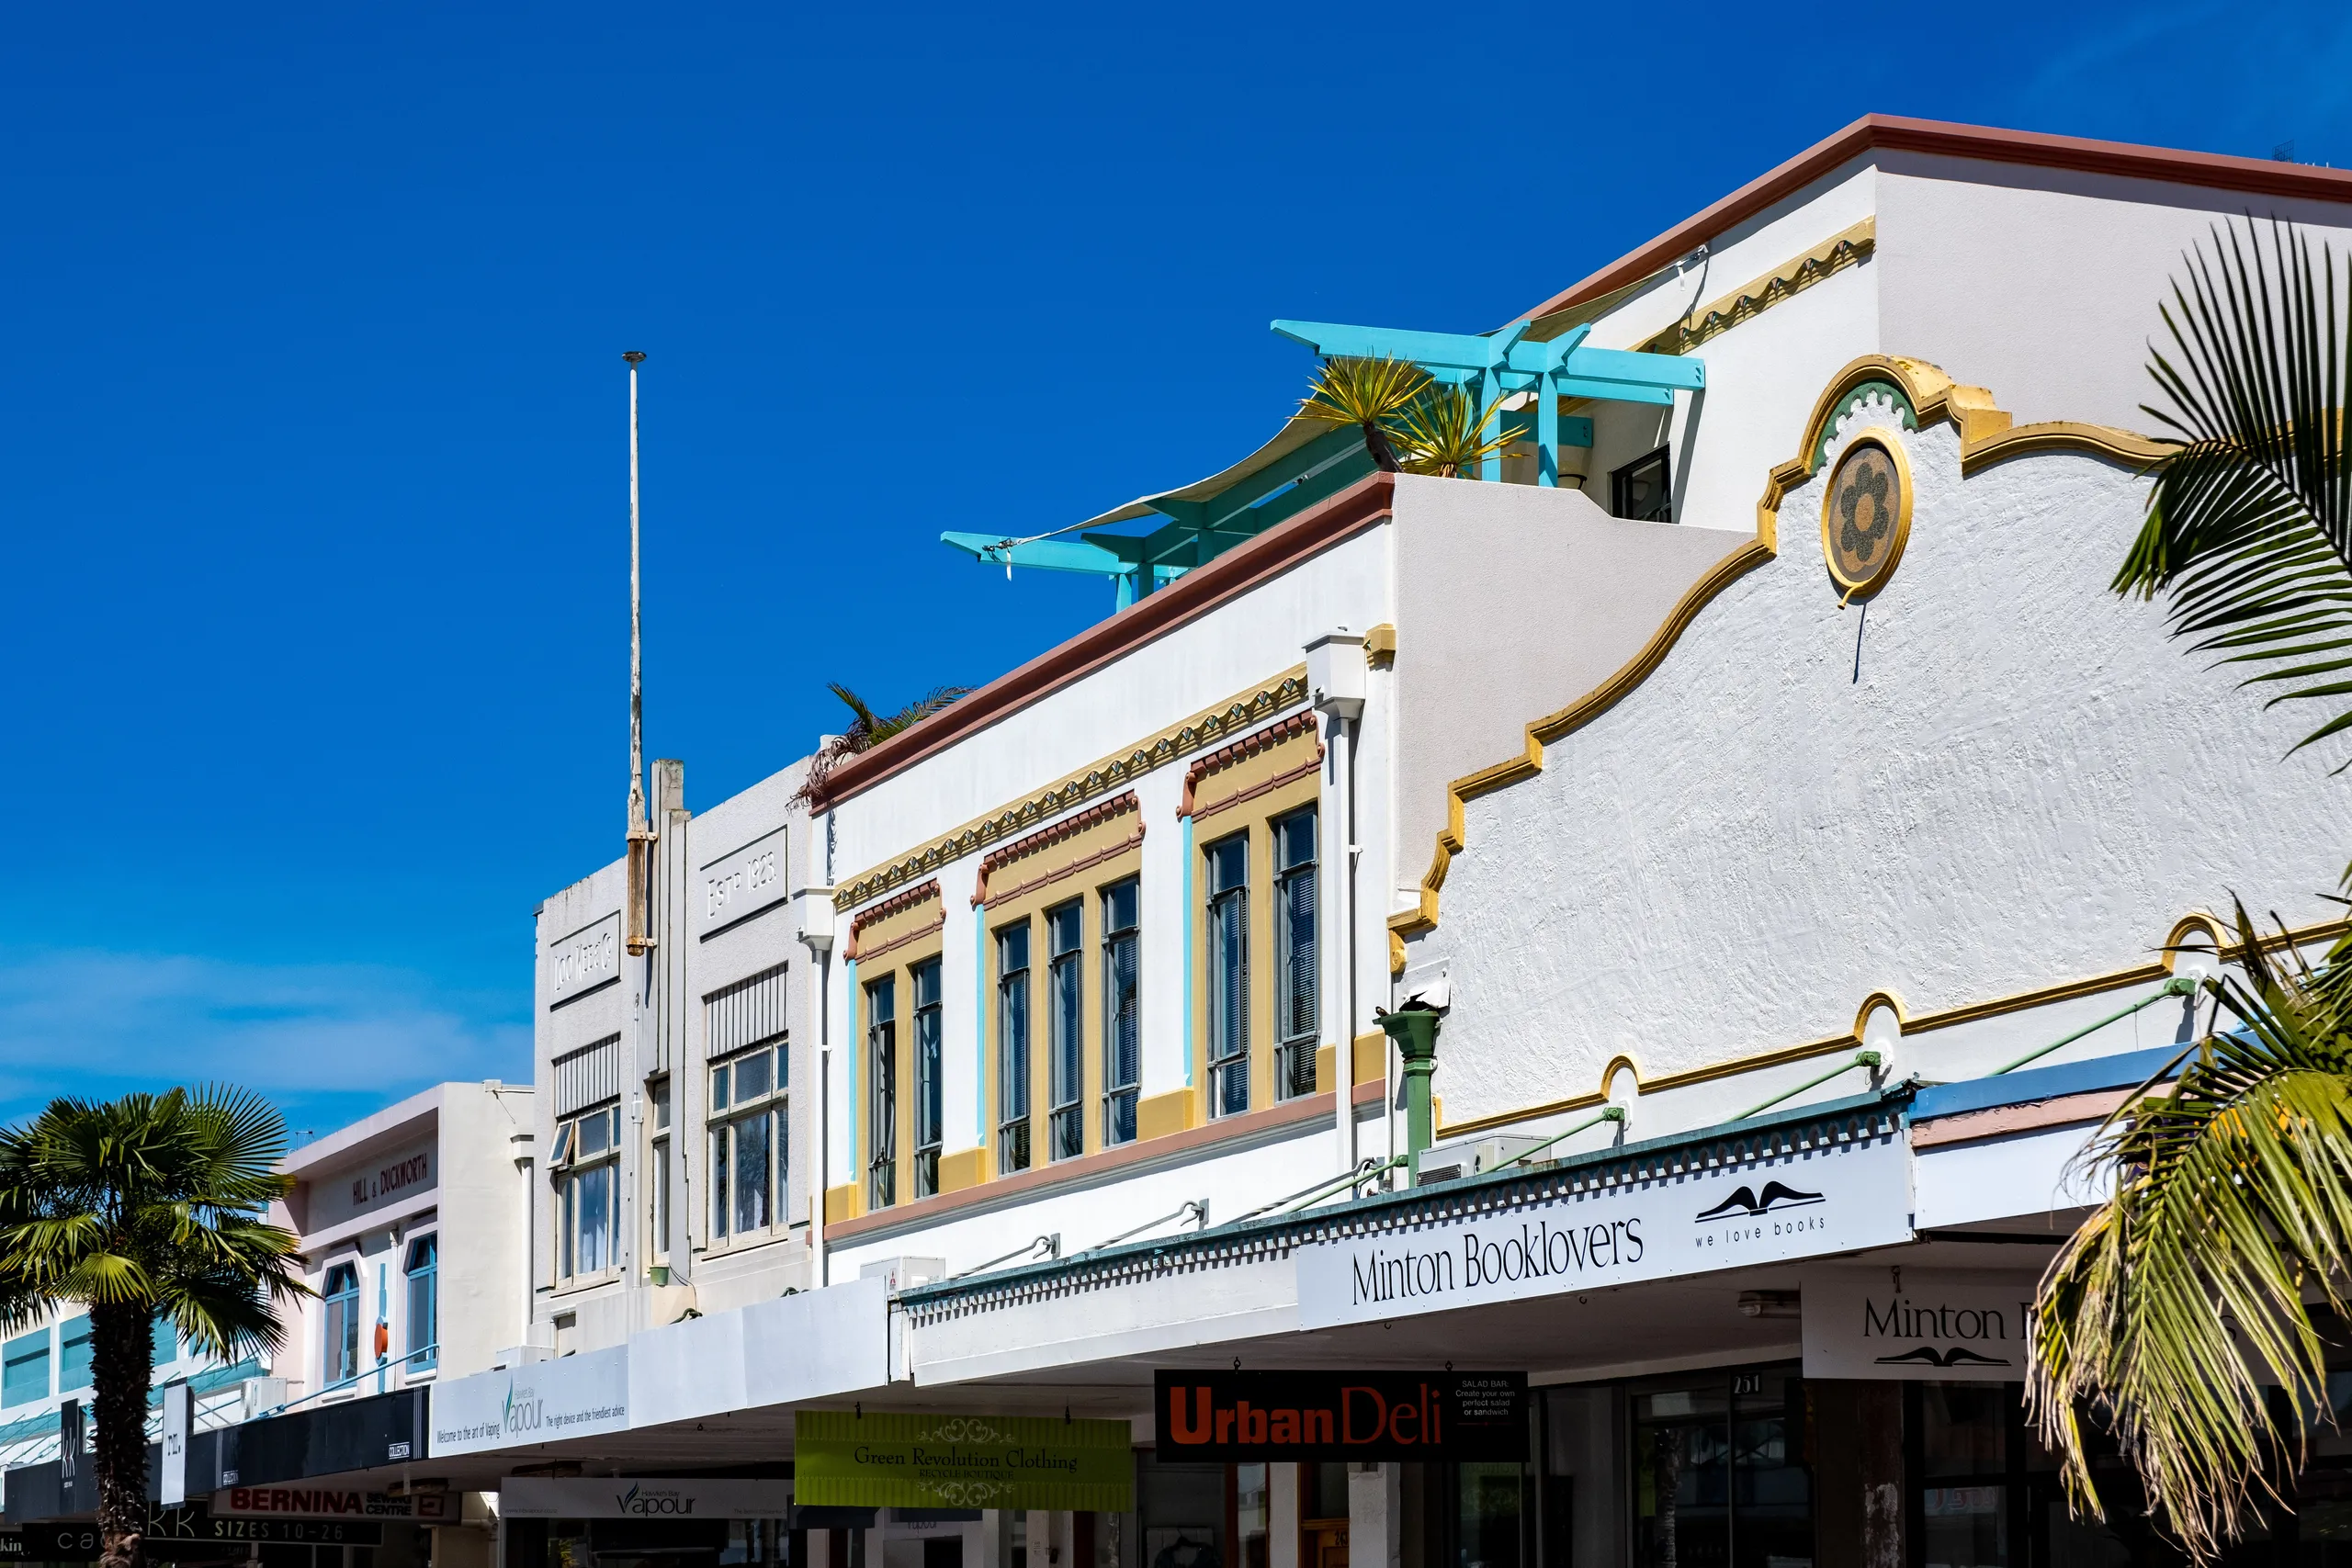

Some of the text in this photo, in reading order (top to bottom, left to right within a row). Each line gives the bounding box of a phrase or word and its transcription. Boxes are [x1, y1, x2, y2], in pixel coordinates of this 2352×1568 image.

[353, 1152, 427, 1206] HILL & DUCKWORTH
[1695, 1216, 1825, 1248] we love books
[1352, 1217, 1644, 1306] Minton Booklovers
[1864, 1298, 2007, 1340] Minton
[1455, 1389, 1480, 1397] Create
[1481, 1390, 1498, 1398] your
[1462, 1380, 1488, 1388] SALAD
[1734, 1374, 1759, 1394] 251
[1462, 1399, 1488, 1408] perfect
[502, 1393, 543, 1438] Vapour
[554, 1413, 562, 1429] right
[563, 1412, 576, 1425] device
[592, 1406, 611, 1420] friendliest
[612, 1404, 625, 1416] advice
[436, 1429, 456, 1443] Welcome
[457, 1429, 462, 1441] to
[480, 1422, 484, 1438] of
[485, 1422, 500, 1439] Vaping
[389, 1444, 410, 1458] COLLECTION
[854, 1446, 1078, 1473] Green Revolution Clothing
[919, 1469, 1014, 1480] RECYCLE BOUTIQUE
[231, 1488, 364, 1515] BERNINA
[366, 1504, 412, 1516] CENTRE
[616, 1489, 695, 1517] Vapour
[214, 1520, 269, 1539] SIZES
